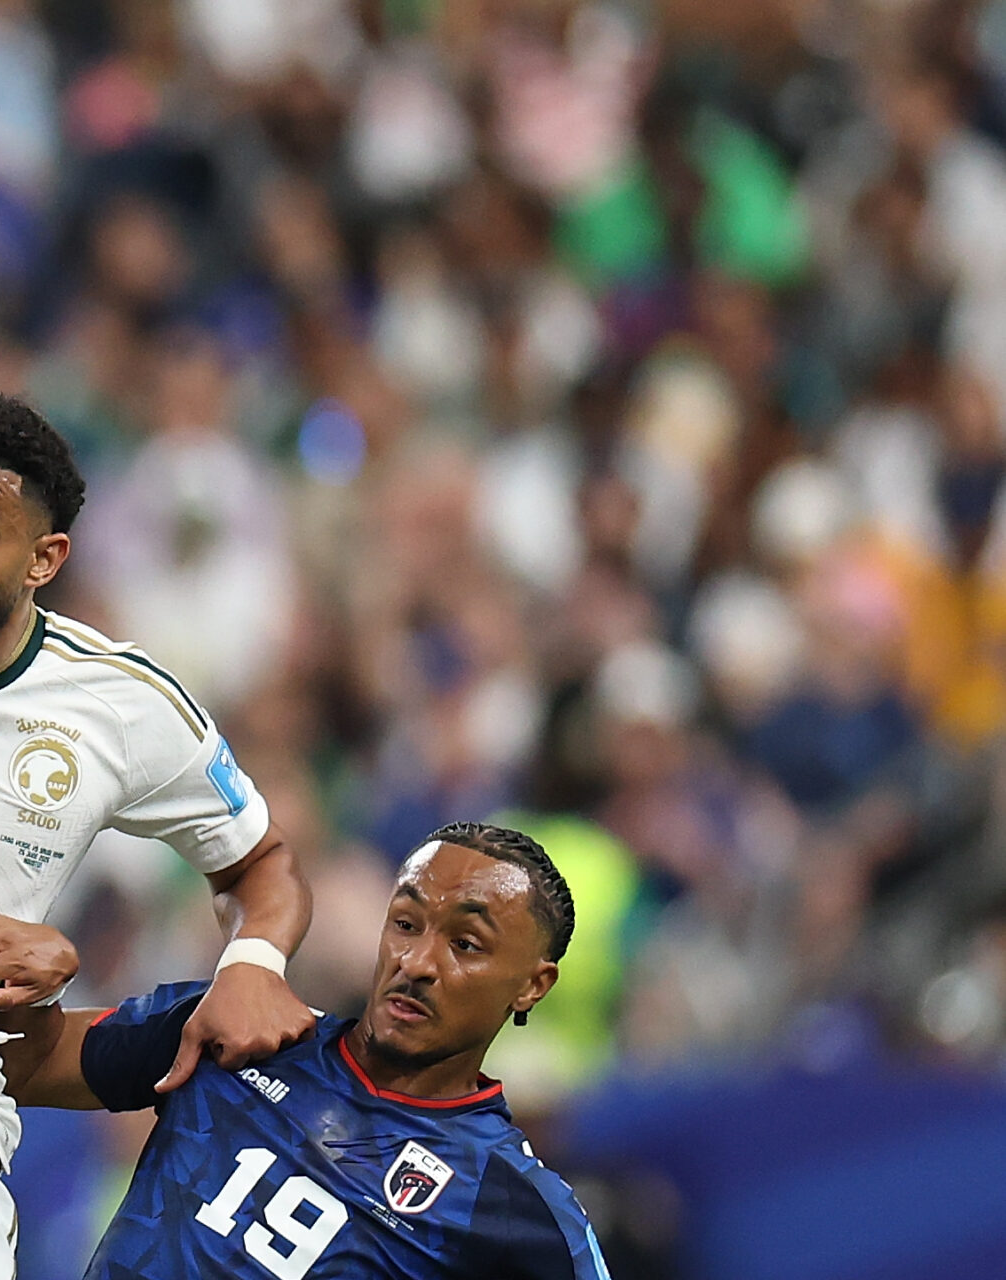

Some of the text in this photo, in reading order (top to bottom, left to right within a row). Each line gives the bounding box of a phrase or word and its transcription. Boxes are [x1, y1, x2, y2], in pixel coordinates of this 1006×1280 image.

[17, 808, 61, 831] SAUDI
[237, 1068, 290, 1102] pelli
[408, 1146, 448, 1174] FCF
